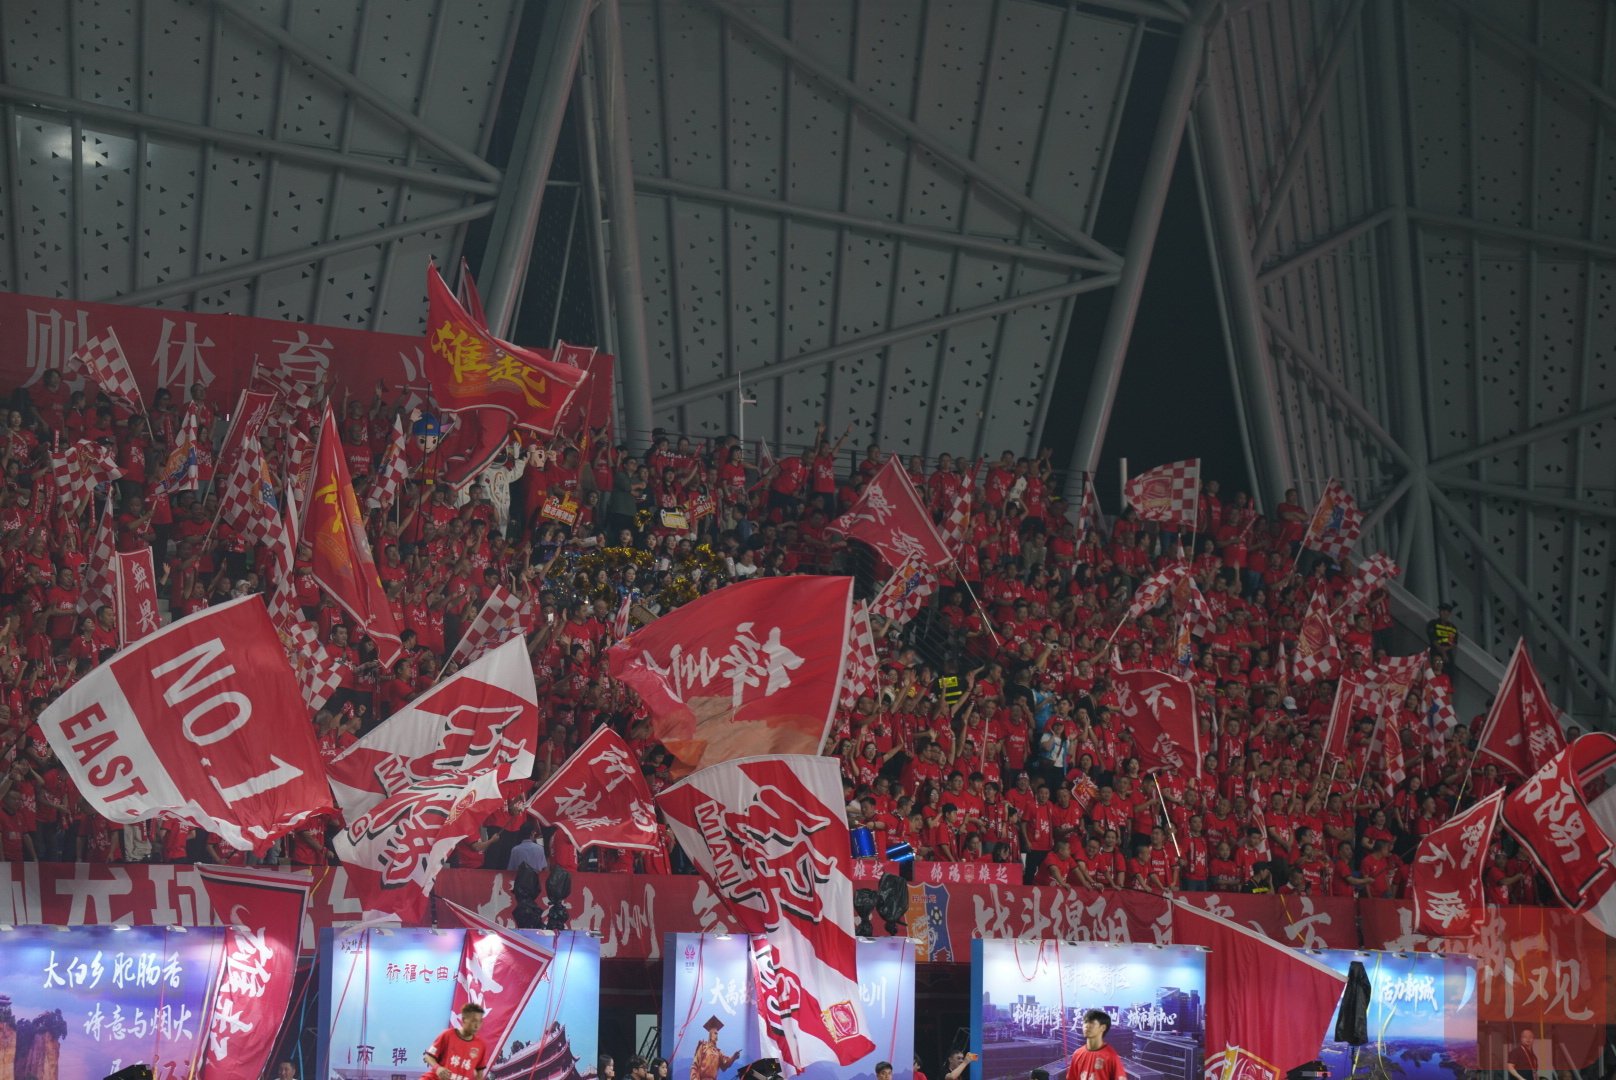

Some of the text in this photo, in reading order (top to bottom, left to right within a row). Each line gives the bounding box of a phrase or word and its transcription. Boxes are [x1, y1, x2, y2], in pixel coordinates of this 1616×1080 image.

[431, 320, 550, 409] 雄起
[58, 702, 151, 802] EAST
[43, 950, 183, 989] 太白乡 肥肠香
[83, 1003, 193, 1042] 诗意与烟火
